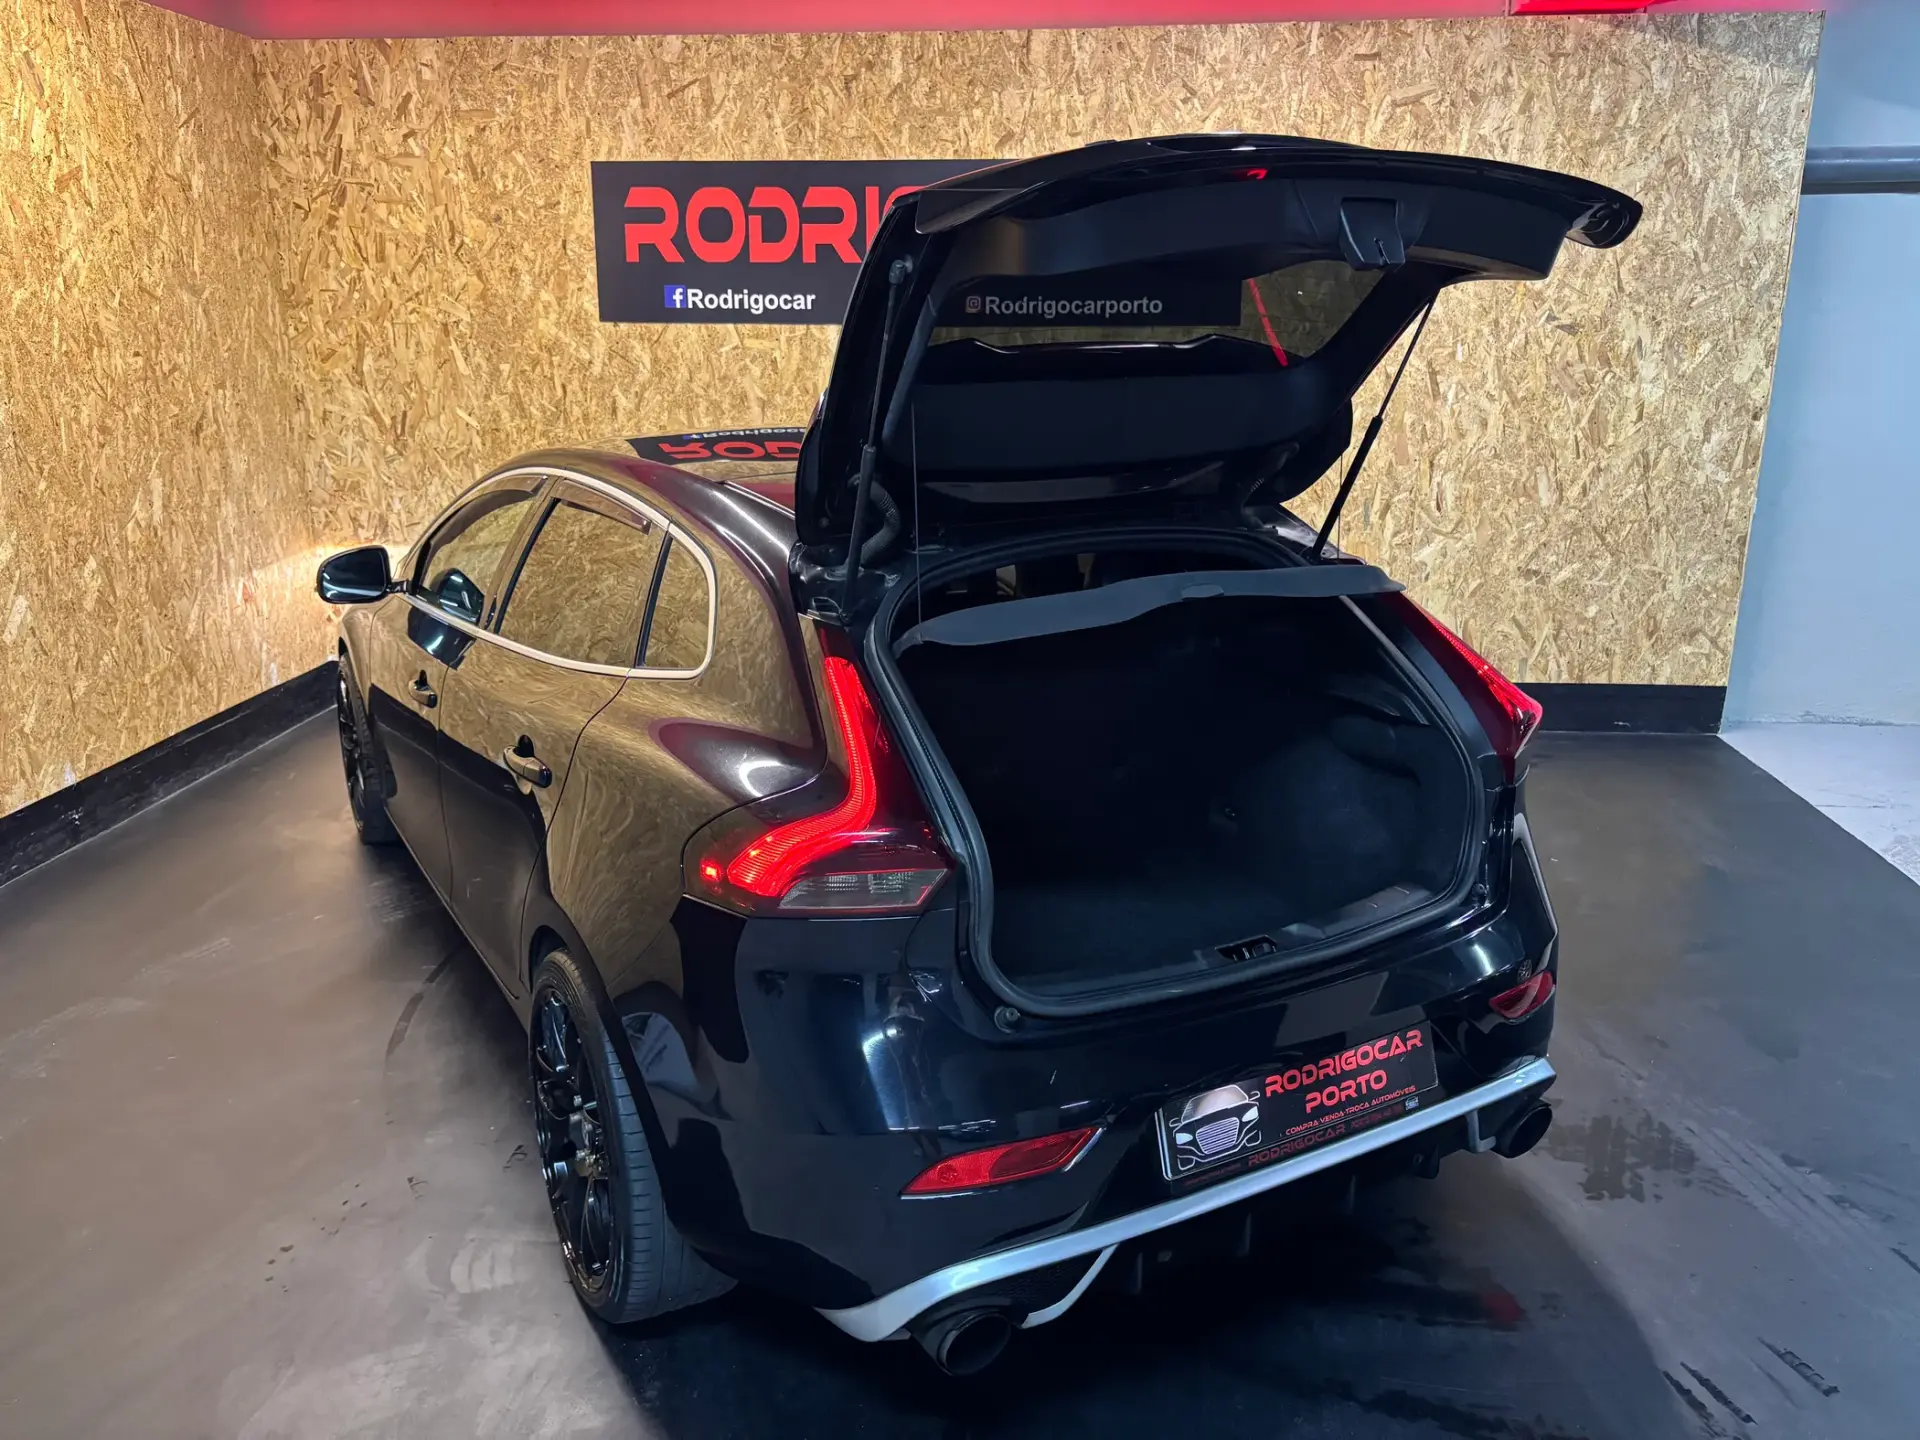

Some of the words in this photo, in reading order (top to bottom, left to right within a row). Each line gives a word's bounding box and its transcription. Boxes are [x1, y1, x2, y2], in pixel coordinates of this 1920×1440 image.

[624, 186, 926, 263] RODRI
[686, 288, 816, 315] Rodrigocar
[985, 296, 1163, 318] Rodrigocarporto
[1265, 1029, 1423, 1098] RODRIGOCAR
[1305, 1069, 1388, 1114] PORTO
[1247, 1124, 1346, 1167] RODRIGOCAR
